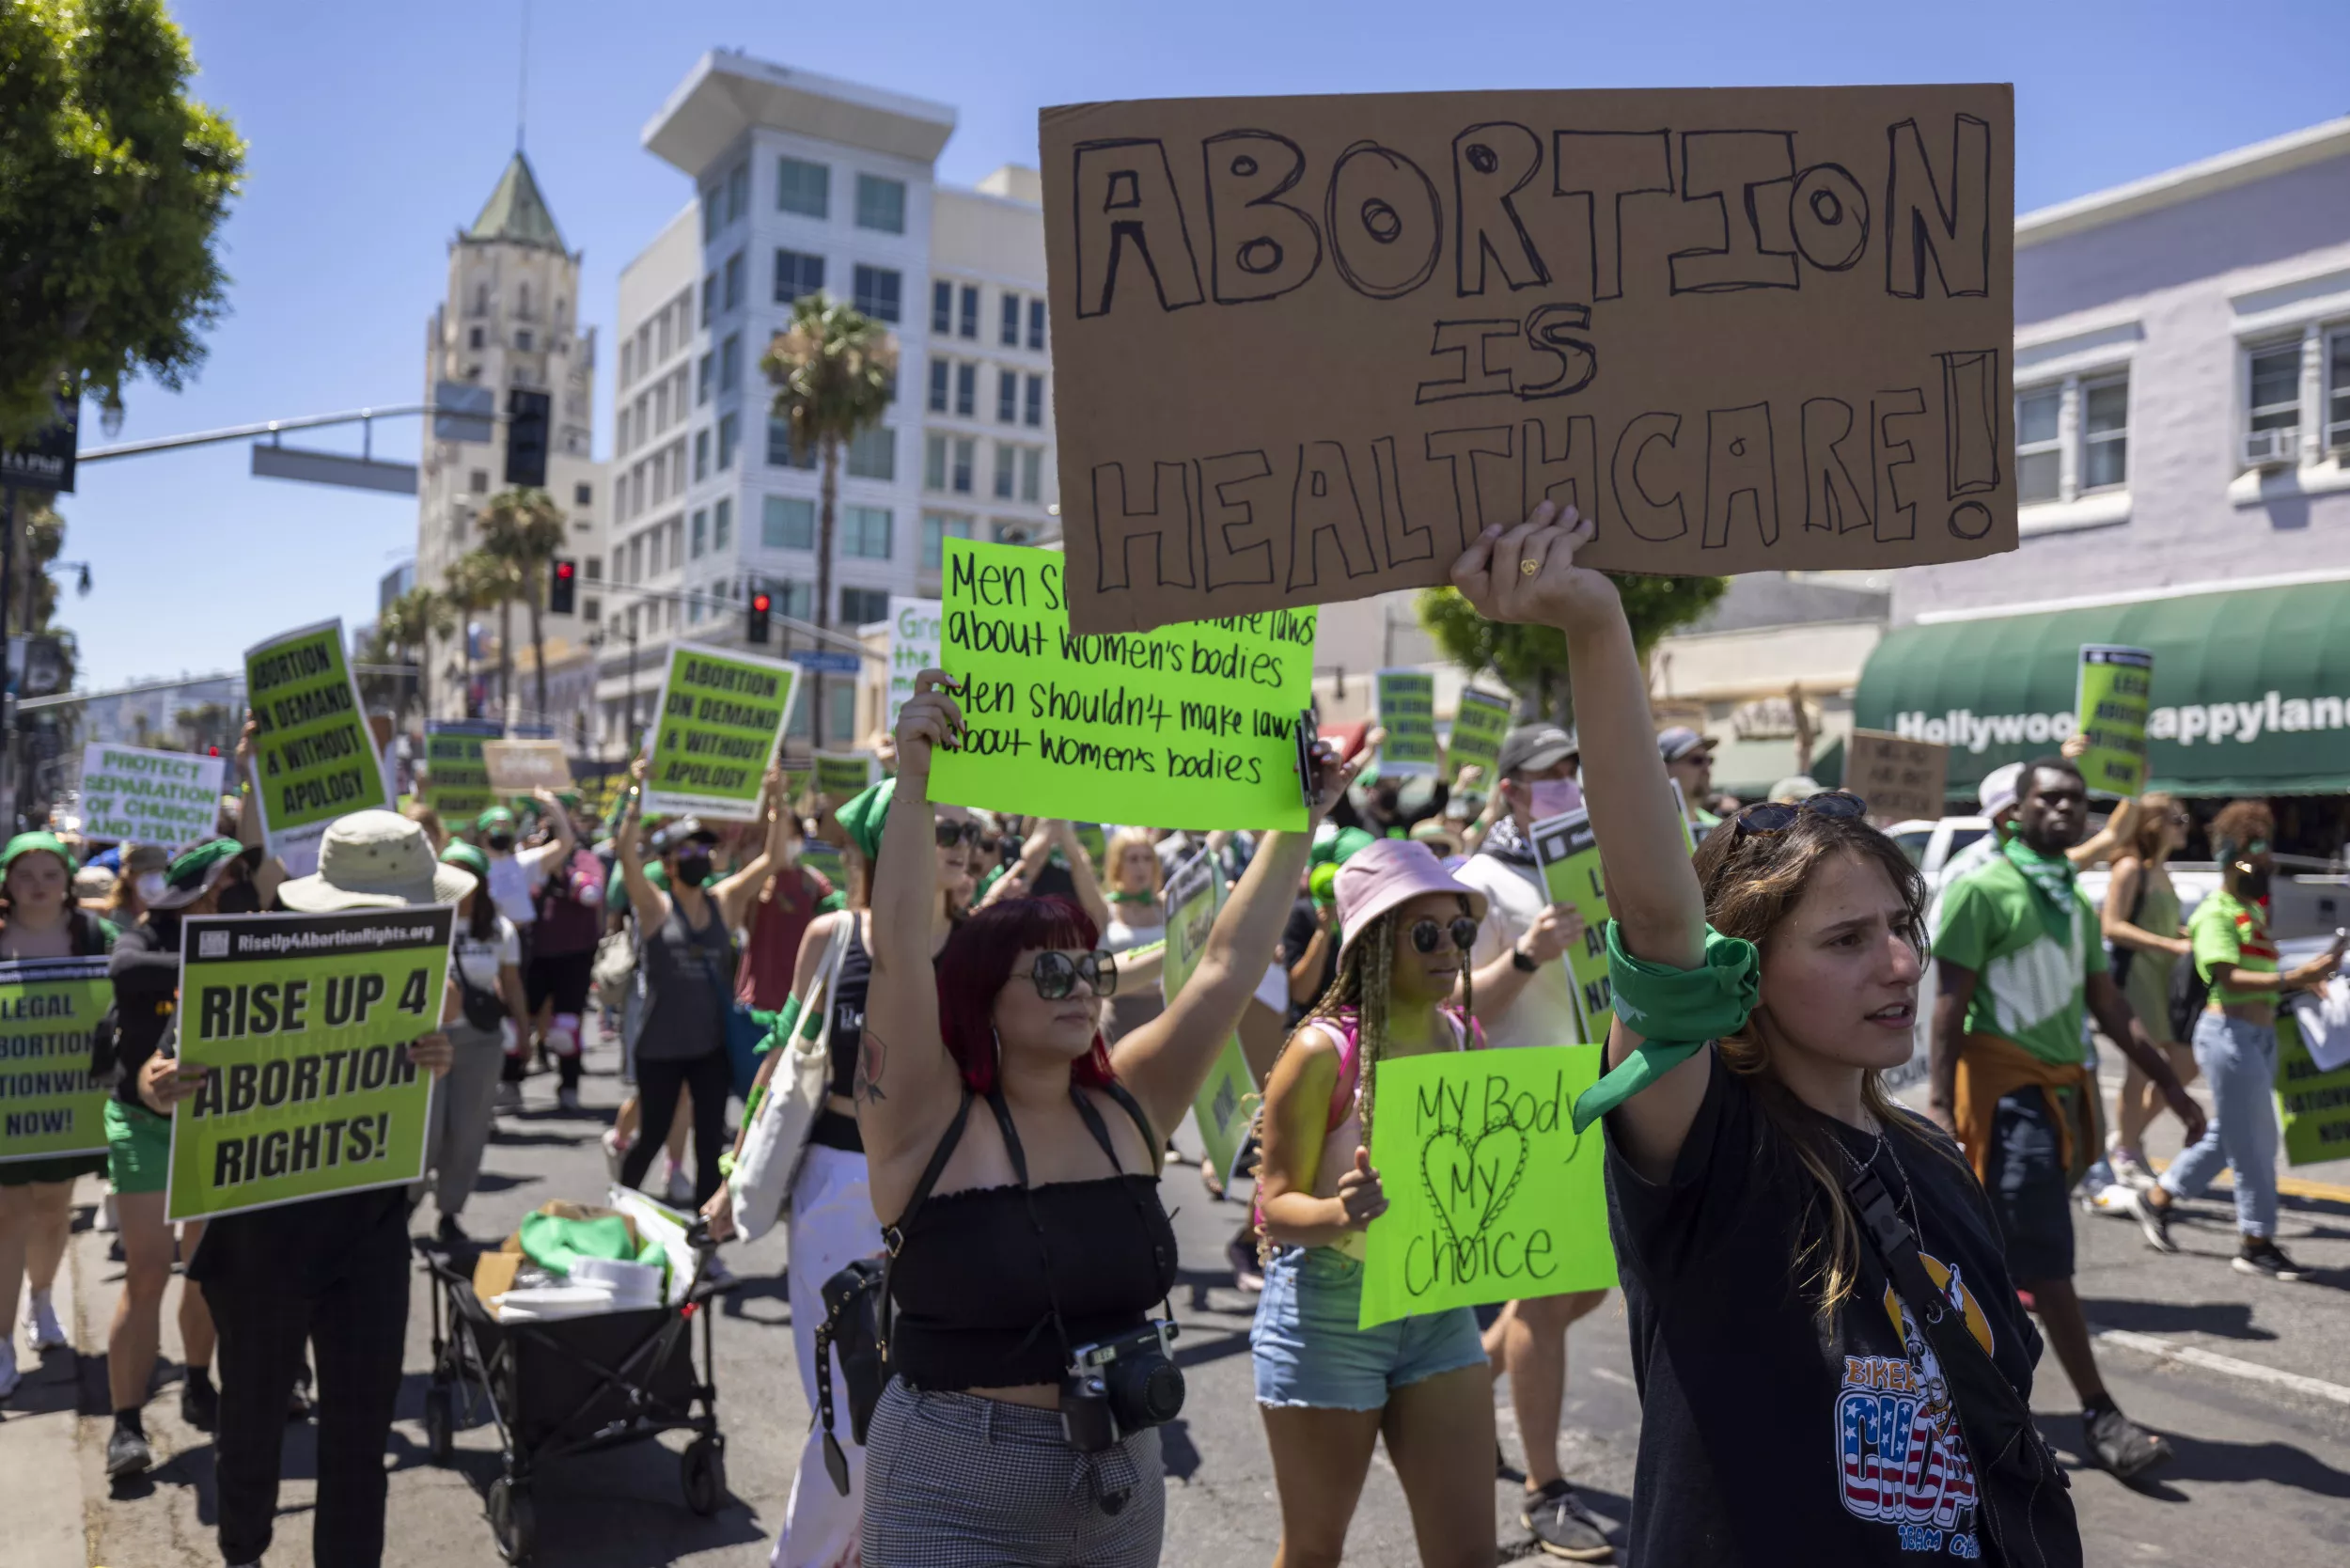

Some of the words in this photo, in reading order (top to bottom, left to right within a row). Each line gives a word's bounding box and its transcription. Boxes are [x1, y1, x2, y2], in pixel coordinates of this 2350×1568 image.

[1073, 113, 1991, 319] ABORTION
[1415, 302, 1598, 405] IS
[951, 551, 1027, 607] Men
[1270, 609, 1318, 646] laws
[253, 641, 332, 693] ABORTION
[948, 610, 1049, 657] about
[1191, 638, 1283, 688] bodies
[683, 660, 779, 699] ABORTION
[274, 682, 352, 729] DEMAND
[666, 691, 696, 717] ON
[697, 697, 781, 731] DEMAND
[943, 671, 1014, 714] Men
[1180, 699, 1243, 737] make
[281, 723, 362, 772] WITHOUT
[684, 729, 769, 760] WITHOUT
[1896, 708, 2078, 754] Hollywoo
[102, 749, 200, 780] PROTECT
[665, 760, 751, 790] APOLOGY
[1167, 746, 1263, 785] bodies
[85, 775, 217, 805] SEPARATION
[86, 796, 114, 814] OF
[123, 799, 213, 824] CHURCH
[283, 766, 365, 816] APOLOGY
[86, 816, 133, 837] AND
[238, 925, 434, 952] RiseUp4AbortionRights.org
[2, 994, 77, 1020] LEGAL
[199, 980, 310, 1041] RISE
[324, 973, 386, 1028] UP
[397, 968, 430, 1015] 4
[193, 1040, 418, 1120] ABORTION
[7, 1107, 74, 1137] NOW!
[213, 1112, 390, 1188] RIGHTS!
[1898, 1524, 1943, 1552] TEAM
